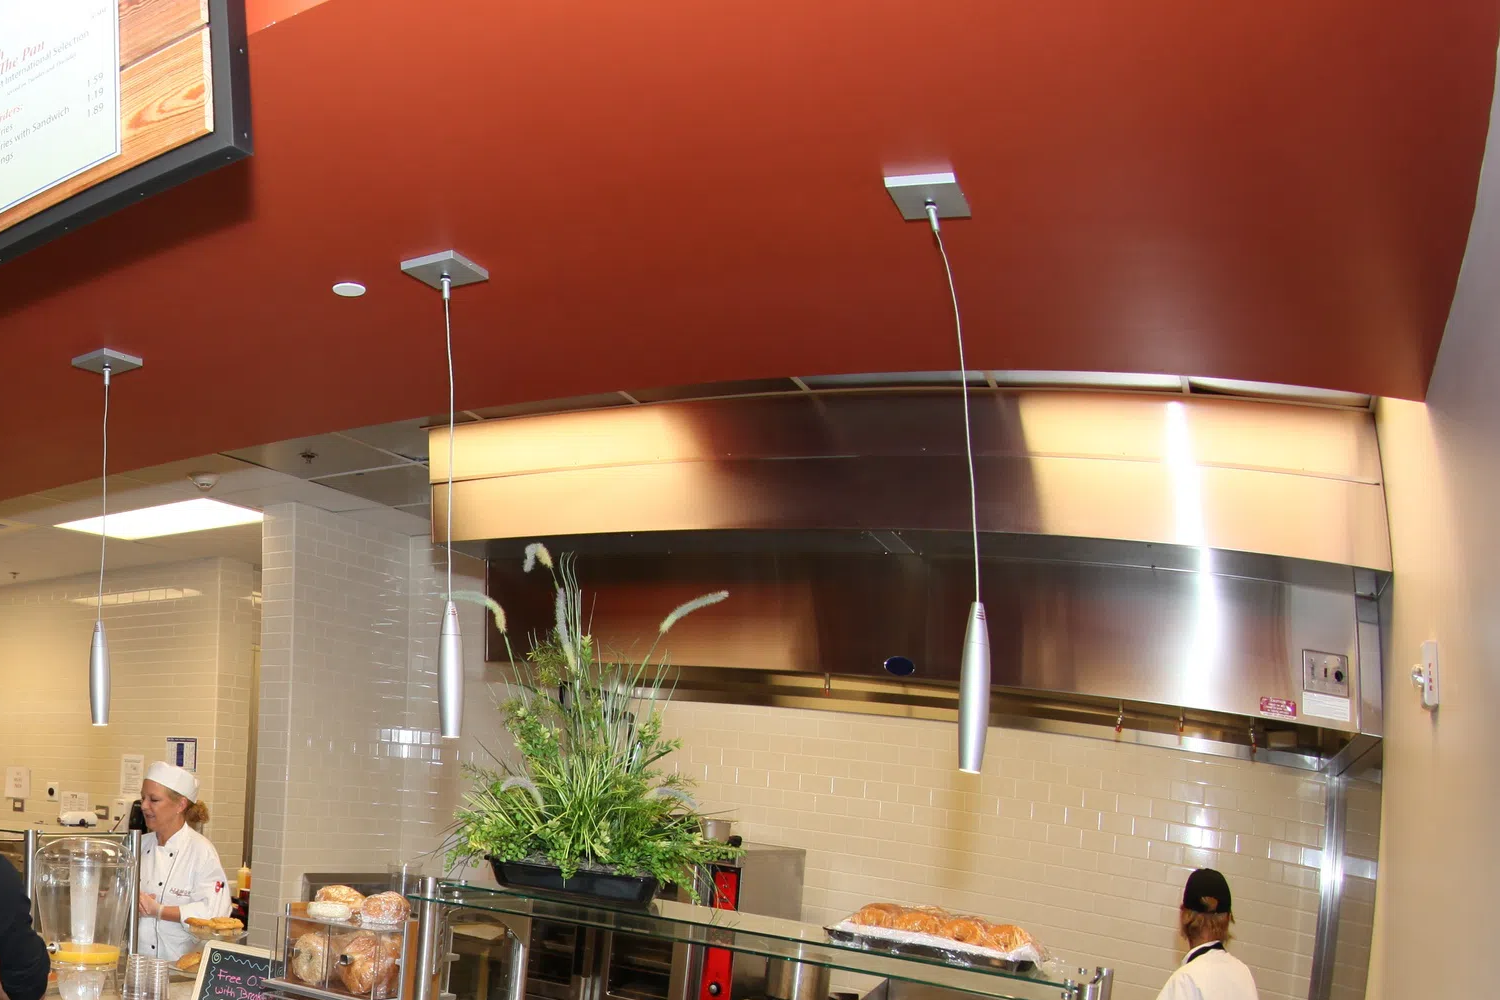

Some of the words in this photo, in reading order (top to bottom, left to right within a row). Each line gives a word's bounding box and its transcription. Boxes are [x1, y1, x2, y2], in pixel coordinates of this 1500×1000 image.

[0, 57, 18, 76] The
[22, 40, 45, 62] Pan
[5, 50, 52, 85] International
[52, 30, 90, 56] Selection
[87, 72, 104, 87] 1.59
[14, 127, 31, 142] with
[32, 105, 70, 132] Sandwich
[87, 87, 104, 102] 1.19
[87, 102, 104, 118] 1.89
[217, 969, 243, 985] Free
[215, 985, 235, 998] with
